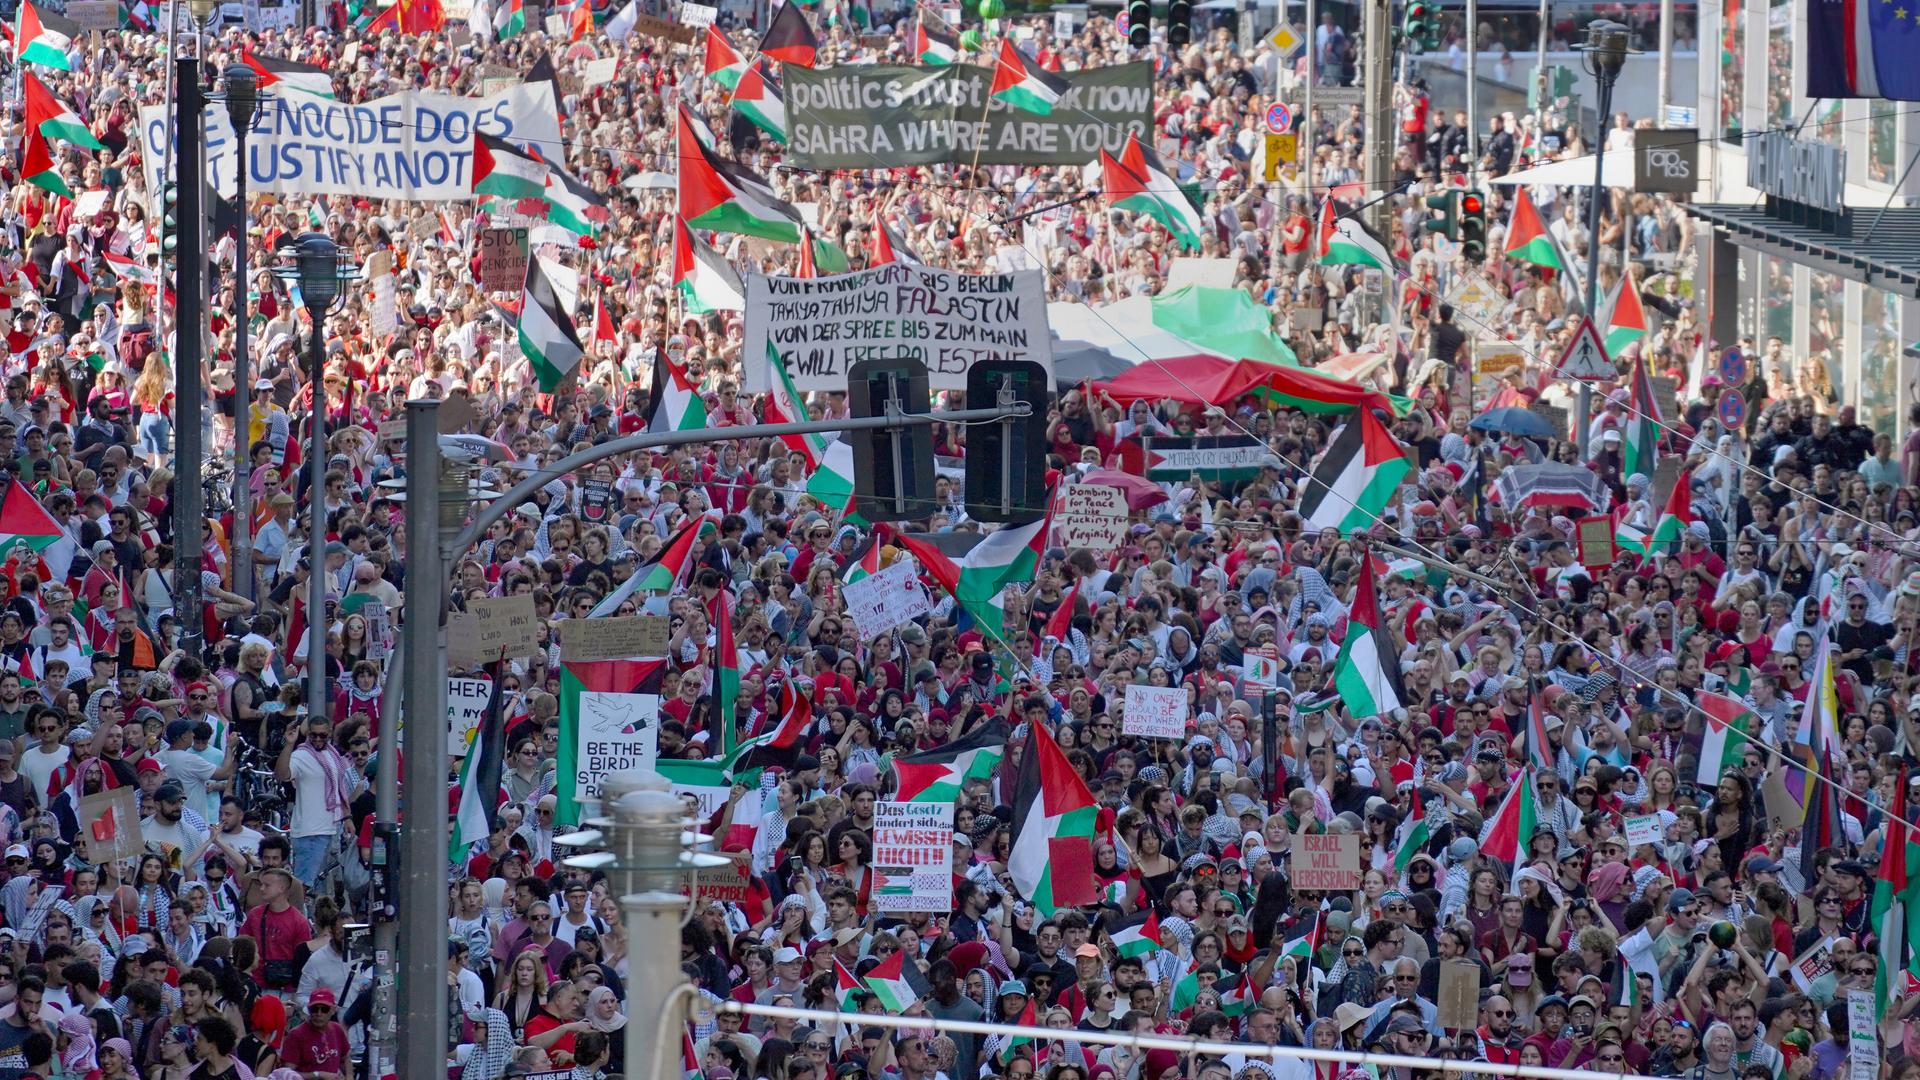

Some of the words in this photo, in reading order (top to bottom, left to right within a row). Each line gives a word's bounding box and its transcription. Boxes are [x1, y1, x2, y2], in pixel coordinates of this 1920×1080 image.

[791, 75, 903, 116] politics
[912, 74, 983, 107] must
[1086, 84, 1150, 114] now
[251, 97, 401, 143] ENOCIDE
[415, 99, 513, 144] DOES
[794, 122, 894, 155] SAHRA
[995, 120, 1059, 153] ARE
[482, 229, 528, 247] STOP
[482, 256, 528, 271] GENOCIDE
[767, 278, 800, 295] VON
[803, 264, 912, 295] FRANKFURT
[919, 271, 950, 292] BIS
[957, 274, 1015, 294] BERLIN
[896, 285, 1020, 324] FALASTIN
[774, 323, 808, 344] VON
[812, 322, 841, 342] DER
[843, 320, 896, 340] SPREE
[902, 320, 931, 340] BIS
[934, 321, 976, 343] ZUM
[980, 327, 1028, 348] MAIN
[797, 347, 839, 377] WILL
[1167, 451, 1201, 467] MOTHERS
[1202, 451, 1216, 465] CRY
[1069, 486, 1113, 500] Bombing
[1069, 498, 1083, 507] for
[1084, 497, 1115, 508] Peace
[1084, 507, 1100, 515] like
[1113, 515, 1128, 525] for
[1069, 527, 1117, 546] Virginity
[475, 608, 491, 619] YOU
[510, 615, 529, 627] HOLY
[481, 631, 501, 640] LAND
[449, 681, 488, 698] HER
[1135, 690, 1148, 705] NO
[1127, 705, 1158, 716] SHOULD
[1160, 706, 1173, 717] BE
[1124, 715, 1152, 724] SILENT
[1155, 716, 1181, 726] WHEN
[1124, 724, 1143, 735] KIDS
[1145, 725, 1160, 735] ARE
[1161, 726, 1184, 736] DYING
[587, 742, 608, 755] BE
[611, 742, 644, 756] THE
[590, 757, 636, 771] BIRD!
[876, 802, 905, 816] Das
[906, 803, 943, 816] Gesetz
[875, 818, 914, 828] ändert
[916, 817, 938, 828] sich
[938, 821, 954, 829] das
[873, 829, 953, 846] GEWISSEN
[1304, 835, 1343, 852] ISRAEL
[877, 847, 944, 866] NICHT!!
[1312, 853, 1340, 869] WILL
[1292, 870, 1361, 890] LEBENSRAUM
